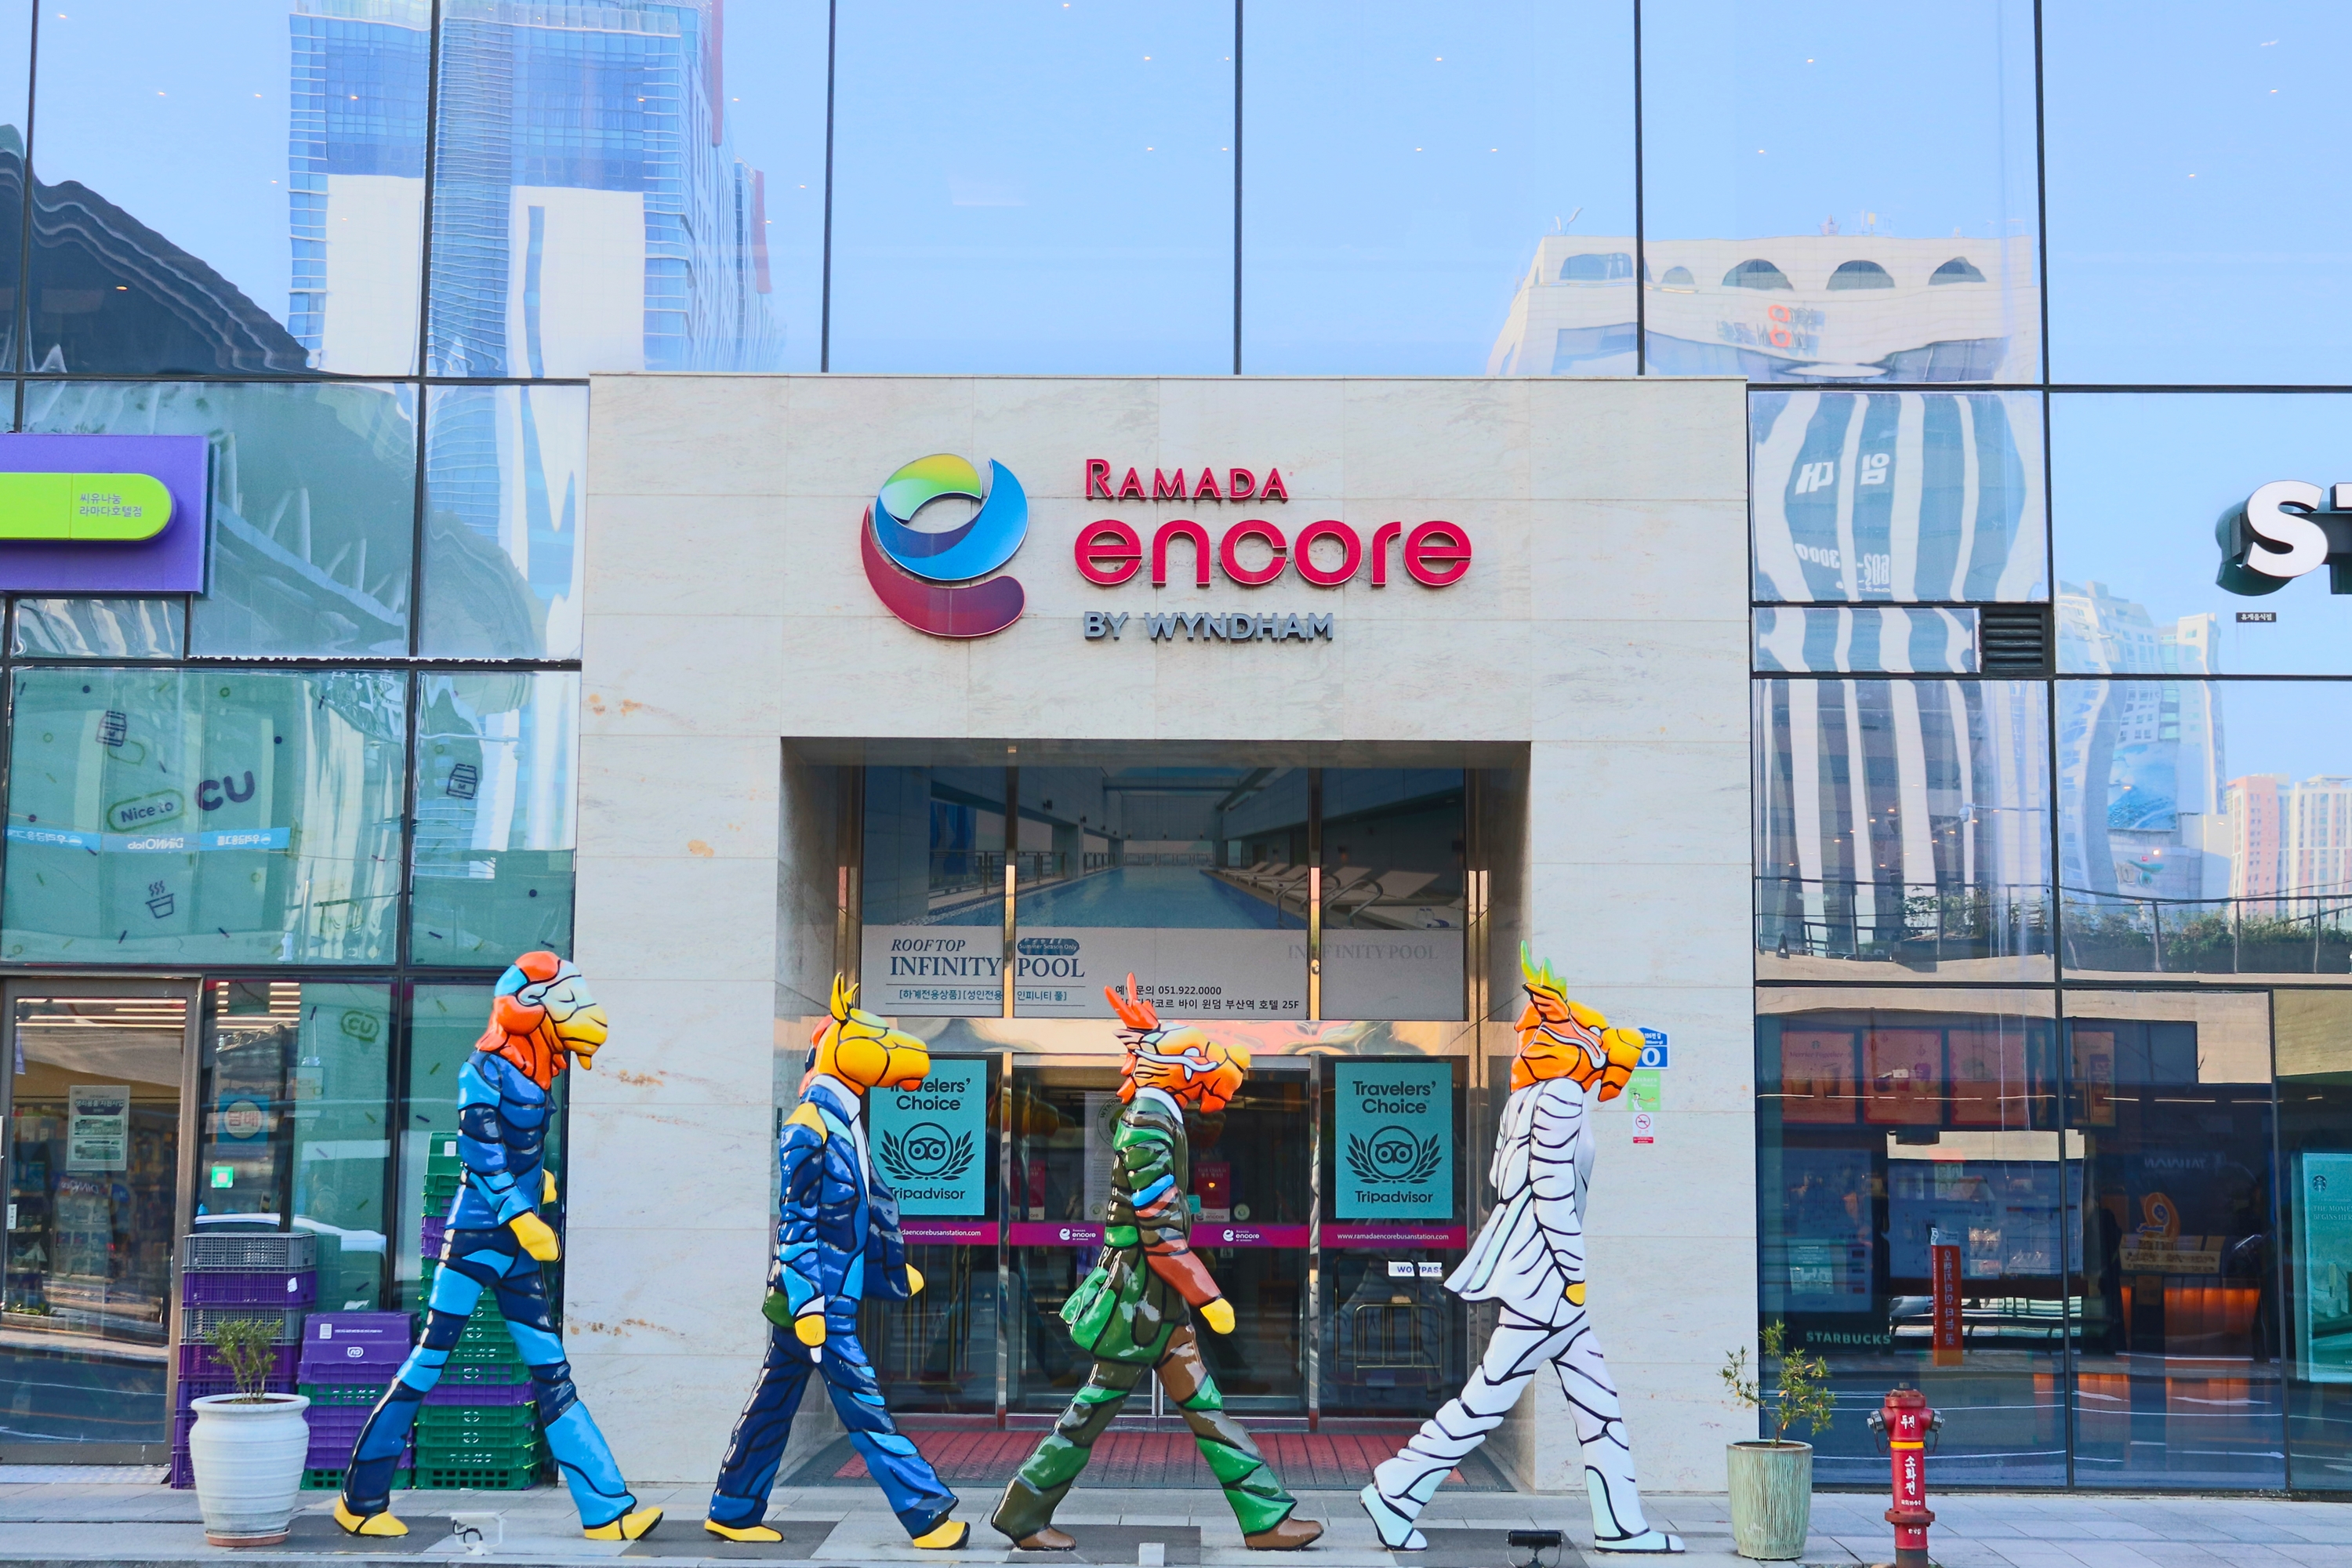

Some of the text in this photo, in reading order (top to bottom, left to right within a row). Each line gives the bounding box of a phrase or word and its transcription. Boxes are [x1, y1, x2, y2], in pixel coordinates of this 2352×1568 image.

[1084, 458, 1288, 502] RAMADA
[79, 493, 122, 505] 씨유나눔
[79, 506, 143, 517] 라마다호텔점
[2246, 479, 2352, 578] S
[1074, 518, 1472, 587] encore
[1083, 611, 1334, 642] BY WYNDHAM
[194, 770, 255, 811] CU
[121, 801, 174, 822] Nice to
[891, 938, 966, 952] ROOFTOP
[1389, 945, 1439, 960] POOL
[890, 956, 1085, 978] INFINITY POOL
[1017, 991, 1051, 1001] 인피니티
[1115, 985, 1221, 996] 예문의 051.922.0000
[1178, 999, 1198, 1009] 바이
[1202, 1000, 1221, 1009] 윈덤
[1225, 1000, 1255, 1010] 부산역
[1259, 1000, 1279, 1010] 호텔
[1282, 1000, 1299, 1009] 25F
[348, 1018, 372, 1033] CU
[1635, 1047, 1661, 1066] 0
[896, 1094, 961, 1111] Choice
[1361, 1098, 1427, 1114] Choice
[1355, 1190, 1434, 1203] Tripadvisor
[1806, 1330, 1891, 1345] STARBUCKS
[1904, 1455, 1917, 1496] 소화전
